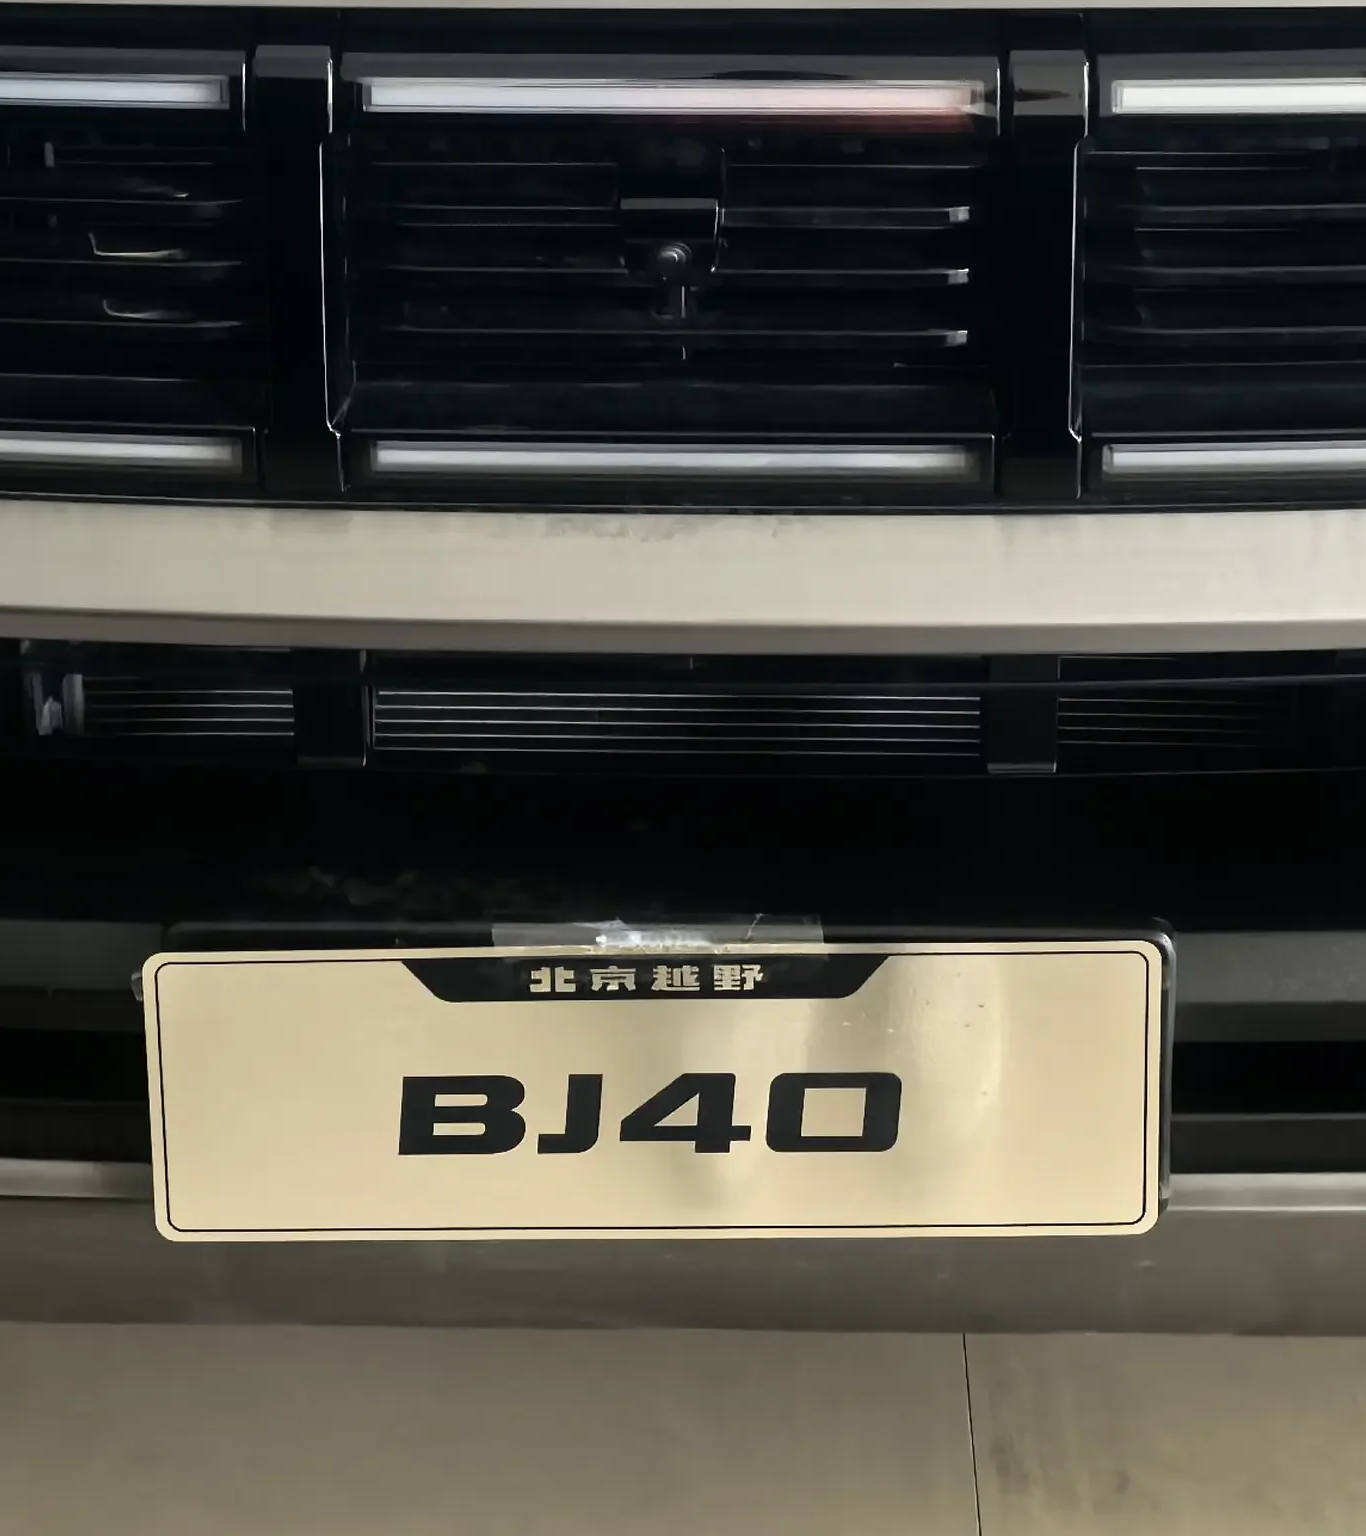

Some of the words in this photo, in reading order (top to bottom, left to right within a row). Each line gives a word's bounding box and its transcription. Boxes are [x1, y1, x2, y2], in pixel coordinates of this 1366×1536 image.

[528, 964, 764, 993] 北京越野
[398, 1072, 903, 1156] BJ40
